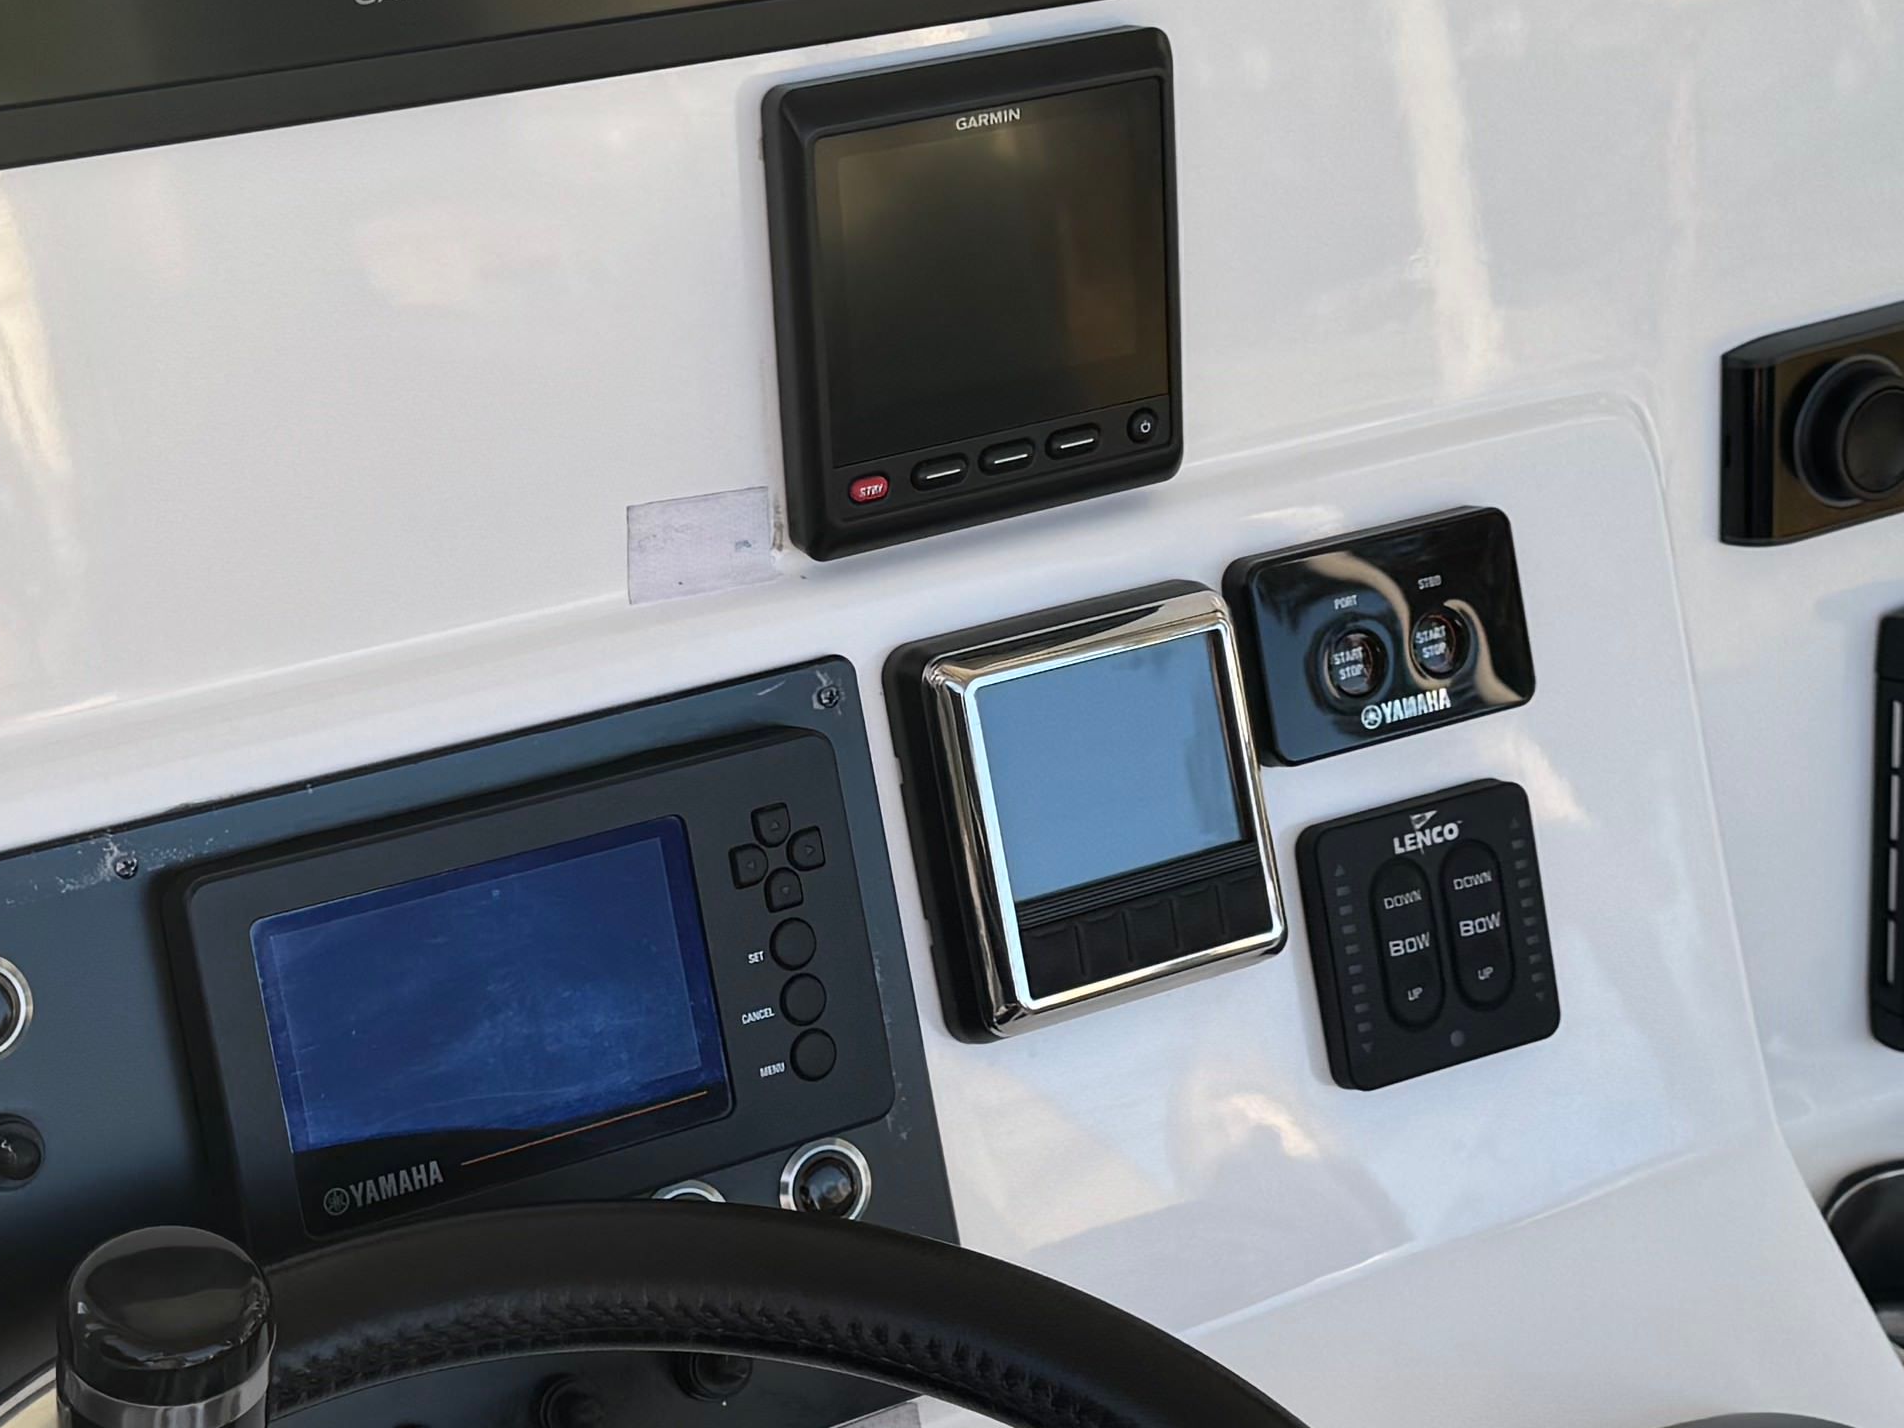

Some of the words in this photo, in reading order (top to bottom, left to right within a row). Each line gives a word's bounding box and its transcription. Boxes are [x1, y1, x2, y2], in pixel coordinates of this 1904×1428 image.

[955, 107, 1021, 131] GARMIN
[1334, 594, 1358, 610] PORT
[1415, 625, 1446, 644] START
[1333, 646, 1364, 665] START
[1422, 642, 1446, 658] STOP
[1339, 664, 1365, 680] STOP
[1381, 688, 1452, 724] YAMAHA
[1393, 821, 1460, 855] LENCO
[1453, 870, 1493, 890] DOWN
[1384, 889, 1423, 909] DOWN
[1459, 911, 1502, 936] BOW
[1389, 932, 1431, 957] BOW
[748, 951, 764, 964] SET
[1478, 966, 1494, 980] UP
[1408, 987, 1424, 1001] UP
[741, 1007, 775, 1025] CANCEL
[760, 1062, 785, 1078] MENU
[349, 1160, 444, 1207] YAMAHA
